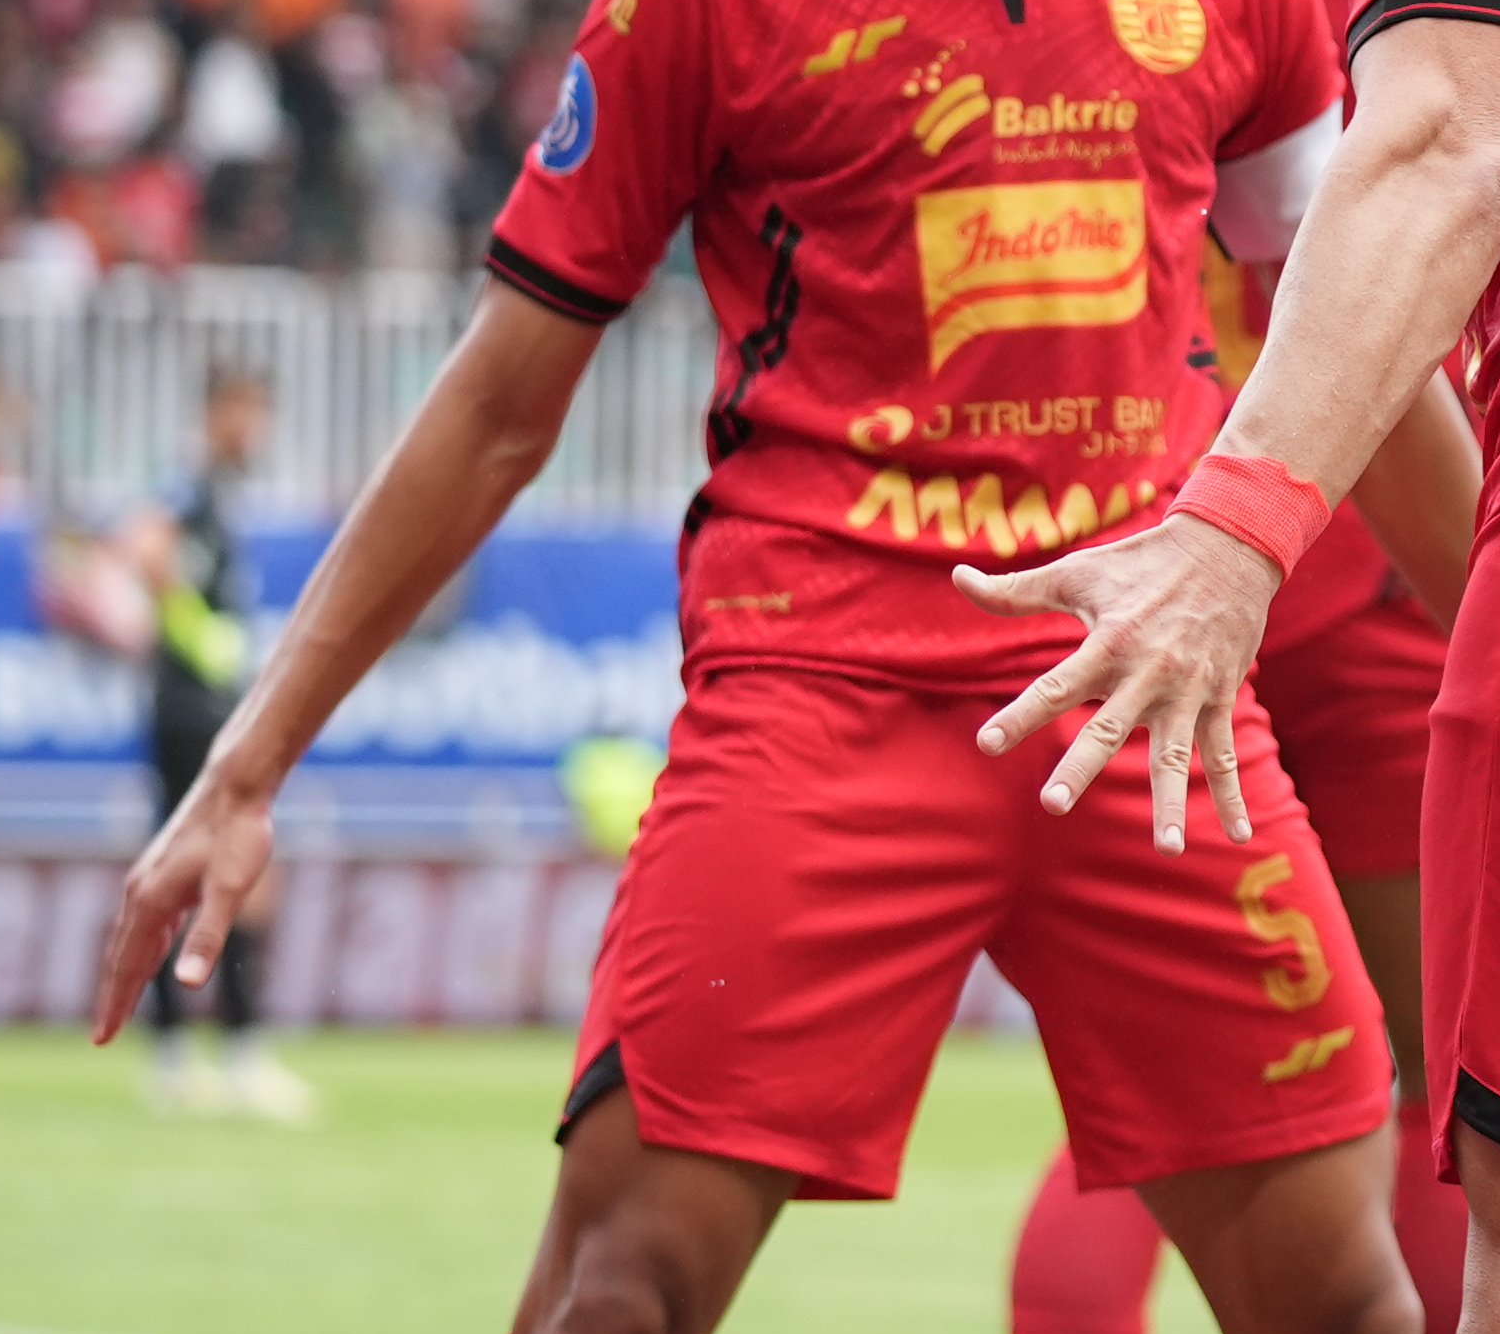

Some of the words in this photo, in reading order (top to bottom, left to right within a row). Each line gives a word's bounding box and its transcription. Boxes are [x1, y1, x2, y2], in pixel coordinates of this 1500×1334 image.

[992, 90, 1139, 139] Bakrie
[948, 207, 1132, 277] Indomie
[921, 403, 953, 442] J
[963, 395, 1101, 438] TRUST
[1235, 852, 1332, 1012] 5
